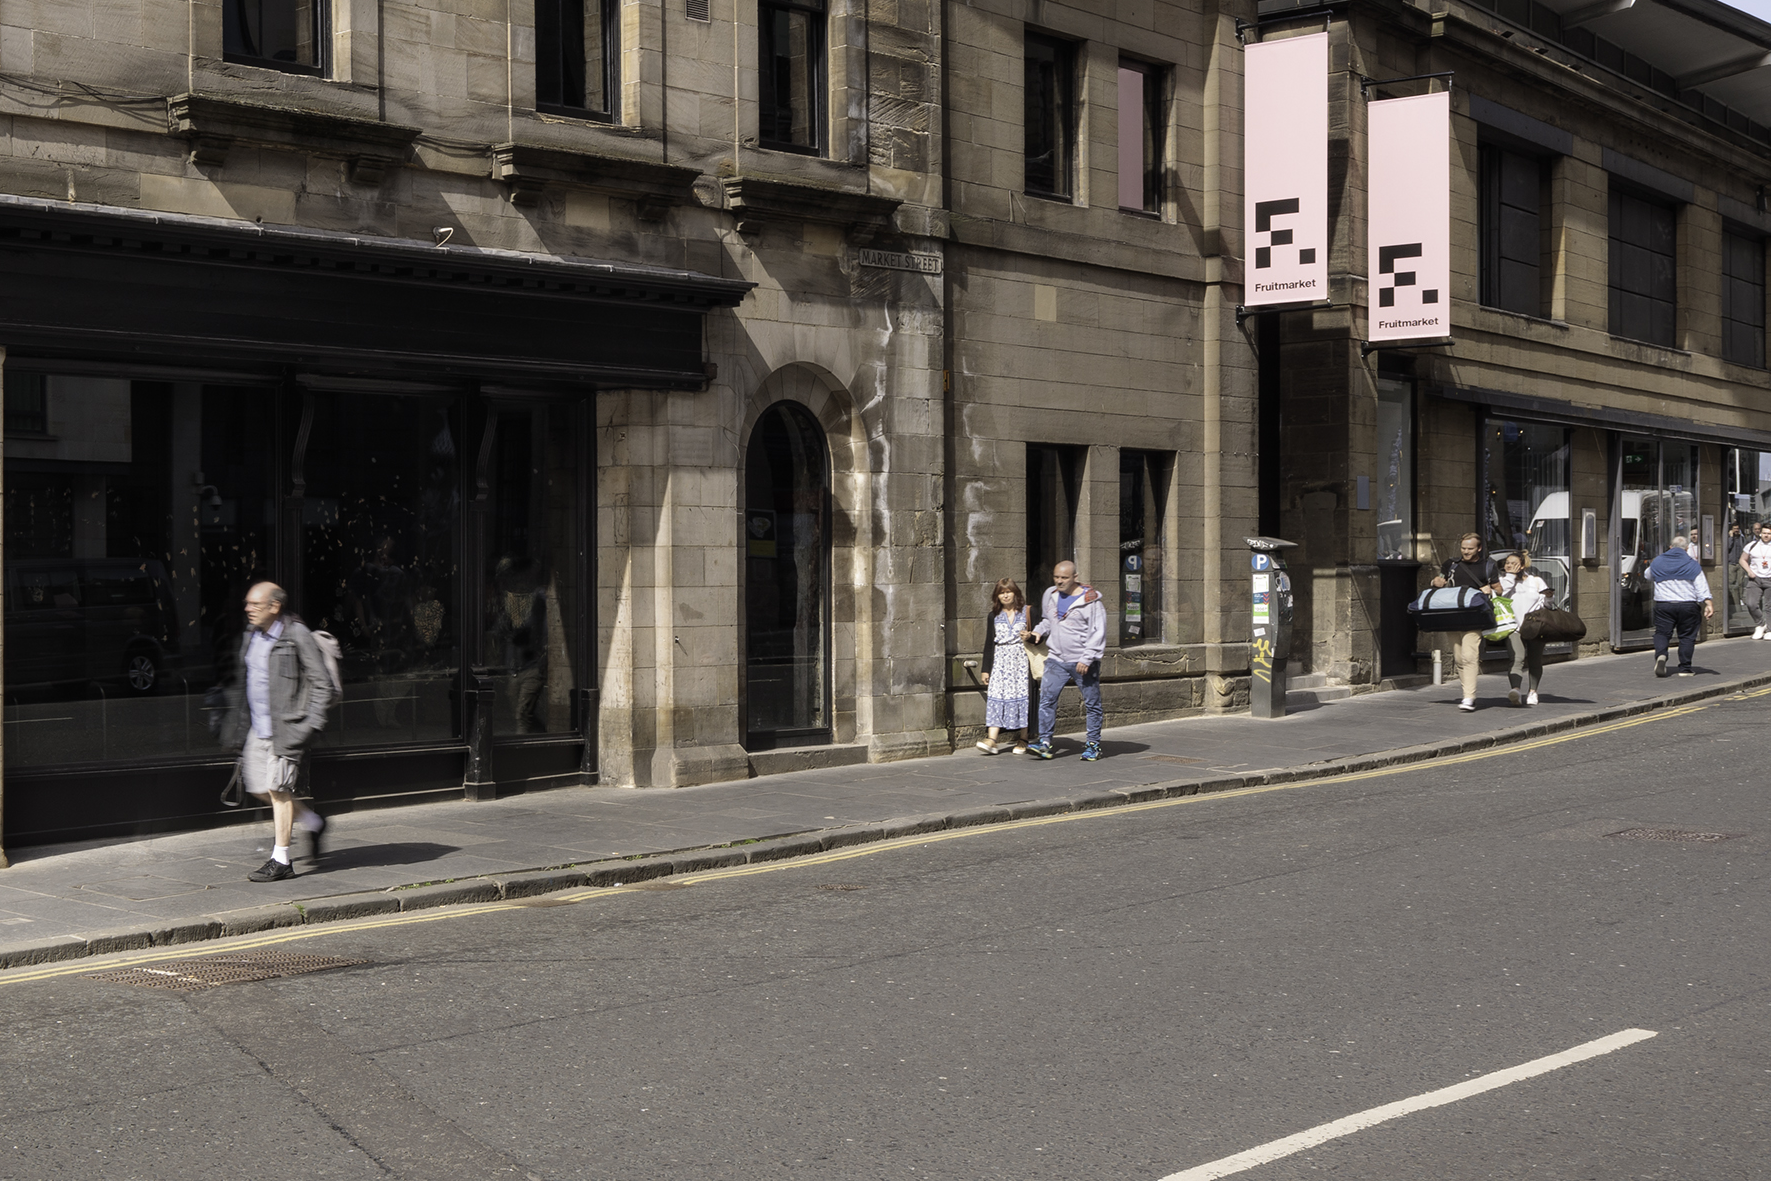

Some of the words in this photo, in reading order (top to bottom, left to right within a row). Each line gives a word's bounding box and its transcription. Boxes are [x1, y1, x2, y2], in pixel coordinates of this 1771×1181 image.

[862, 250, 901, 267] MARKET
[905, 255, 938, 272] STREET
[1255, 279, 1316, 292] Fruitmarket
[1378, 317, 1439, 328] Fruitmarket
[1257, 555, 1267, 569] P
